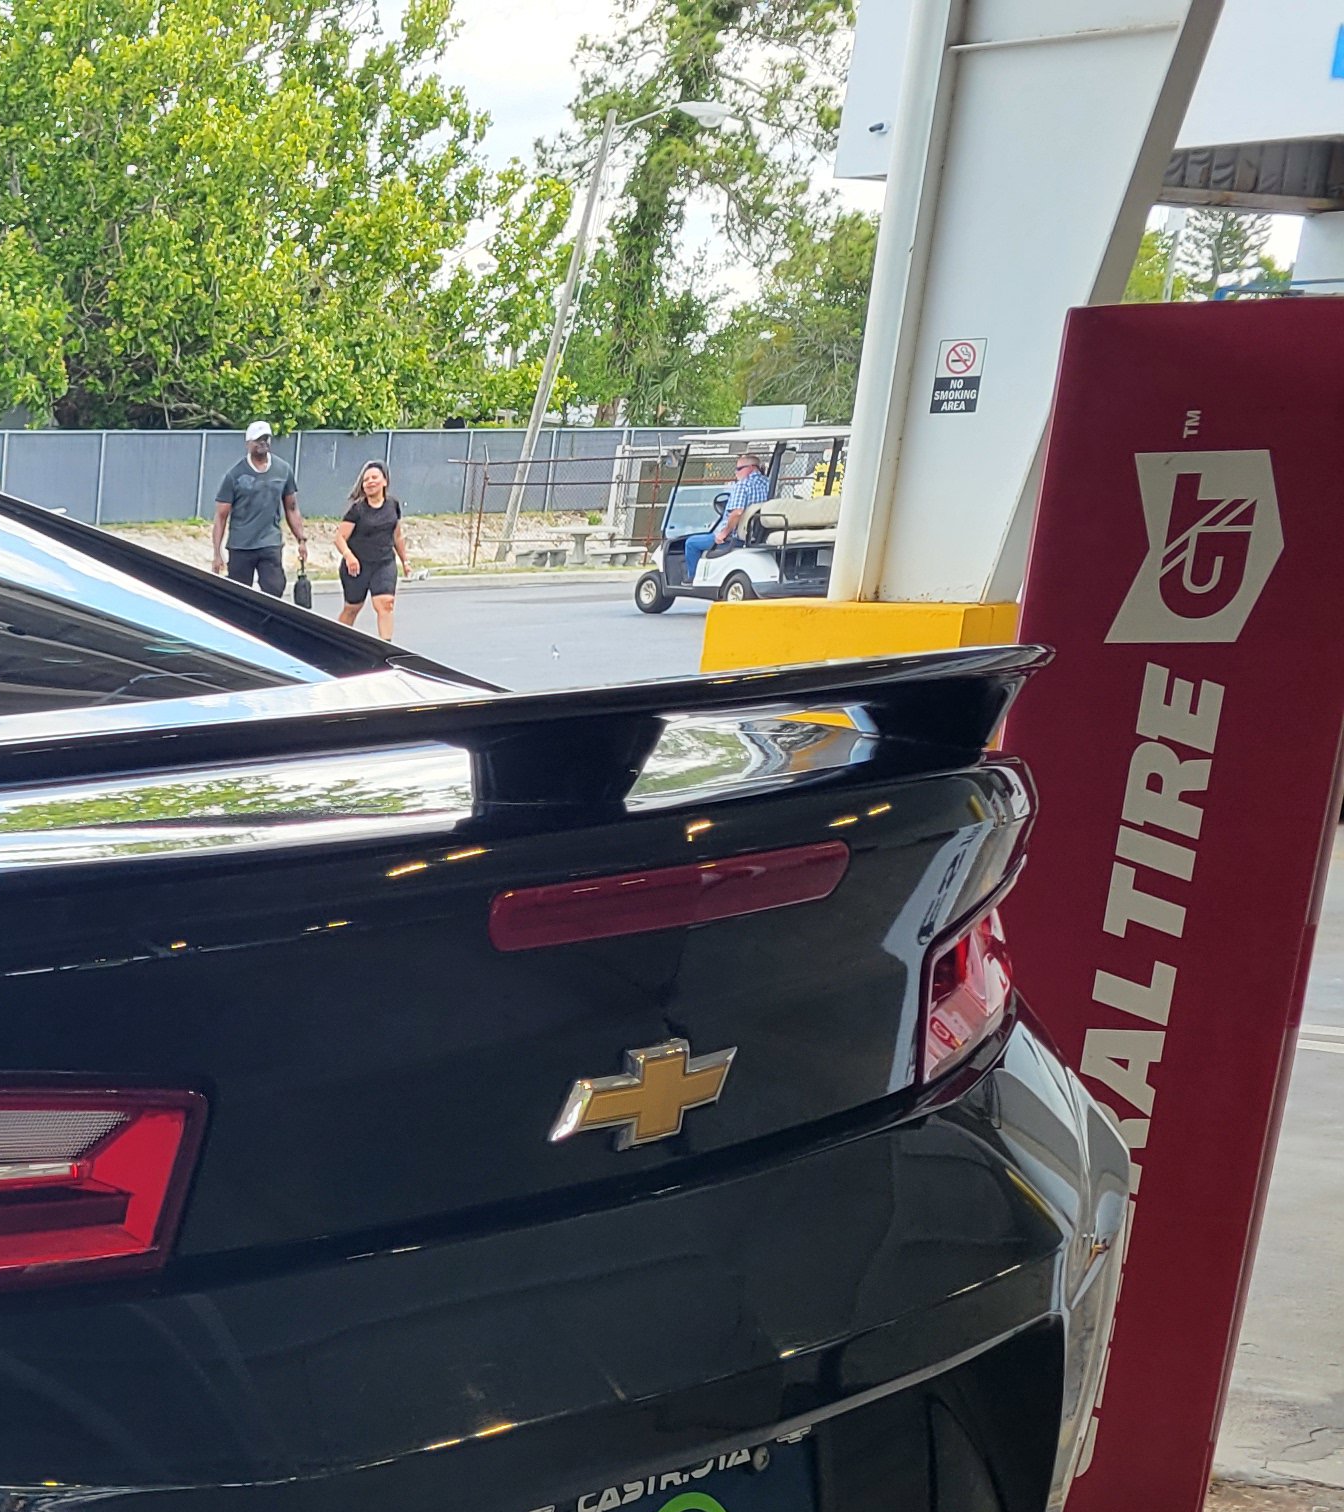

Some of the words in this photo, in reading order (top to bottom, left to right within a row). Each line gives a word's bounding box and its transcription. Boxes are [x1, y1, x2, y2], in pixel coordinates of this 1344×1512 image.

[949, 378, 964, 390] NO
[933, 389, 977, 401] SMOKING
[940, 400, 966, 411] AREA
[1103, 661, 1225, 938] TIRE
[1183, 409, 1202, 438] TM
